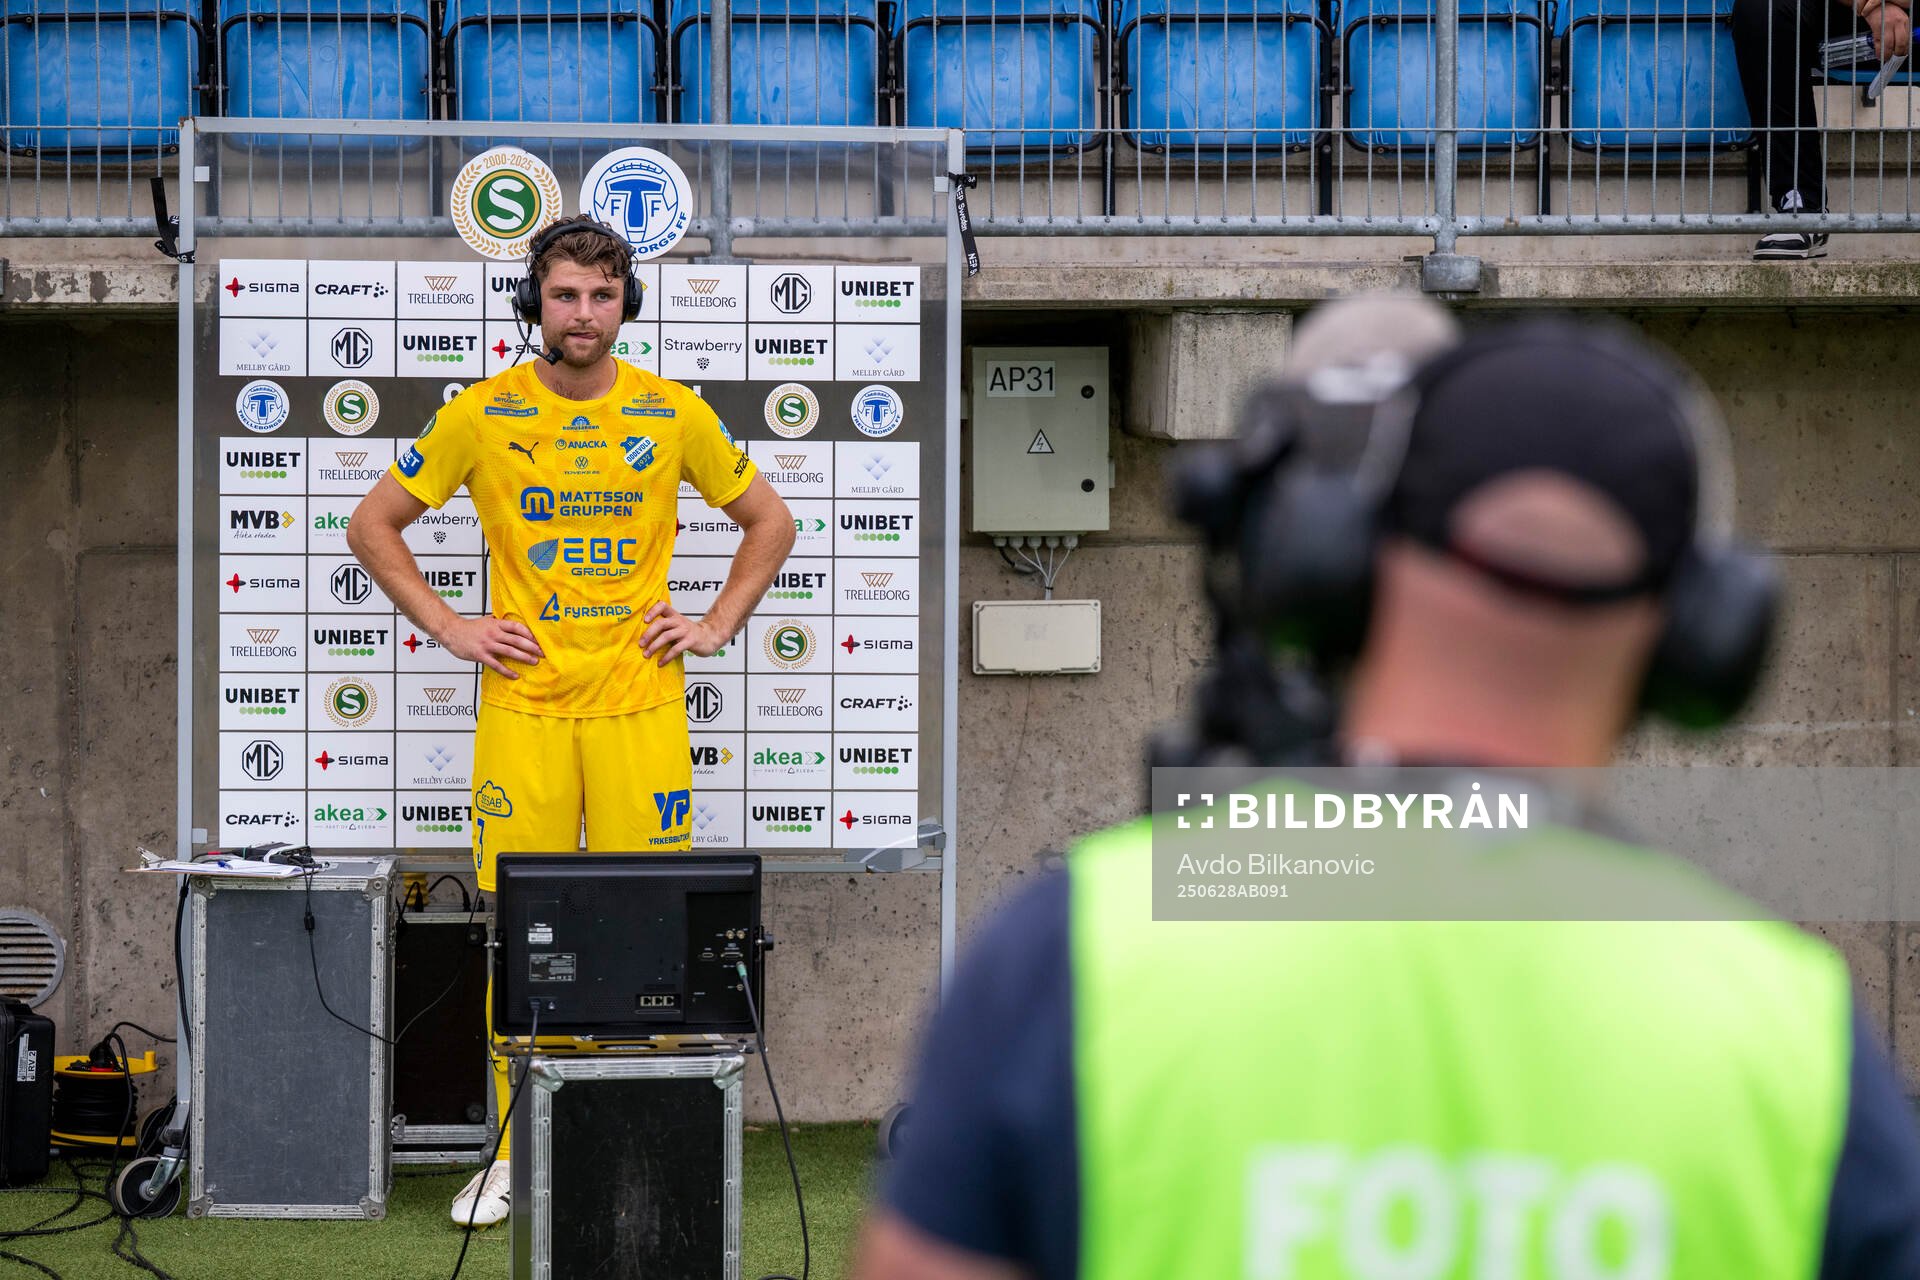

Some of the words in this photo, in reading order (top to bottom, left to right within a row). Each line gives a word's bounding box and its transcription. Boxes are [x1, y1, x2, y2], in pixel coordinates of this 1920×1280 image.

[483, 153, 534, 171] 2000-2025
[315, 284, 373, 296] CRAFT
[774, 277, 808, 311] MG
[841, 281, 914, 297] UNIBET
[408, 293, 474, 305] TRELLEBORG
[670, 296, 737, 308] TRELLEBORG
[335, 332, 369, 366] MG
[403, 335, 478, 351] UNIBET
[664, 338, 742, 354] Strawberry
[755, 339, 828, 355] UNIBET
[236, 364, 267, 372] MELLBY
[269, 362, 291, 372] GÅRD
[852, 369, 881, 377] MELLBY
[883, 368, 905, 377] GÅRD
[989, 366, 1055, 392] AP31
[568, 440, 608, 449] ANACKA
[626, 439, 652, 463] ODDEVOLD
[226, 452, 300, 468] UNIBET
[319, 469, 385, 481] TRELLEBORG
[560, 491, 644, 503] MATTSSON
[882, 485, 904, 494] GÅRD
[560, 505, 633, 517] GRUPPEN
[231, 510, 280, 530] MVB
[314, 512, 350, 530] ake
[411, 513, 479, 527] rawberry
[840, 515, 913, 531] UNIBET
[563, 537, 637, 565] EBC
[571, 567, 630, 577] GROUP
[334, 567, 369, 601] MG
[667, 580, 723, 592] CRAFT
[769, 573, 826, 589] NIBET
[844, 589, 910, 601] TRELLEBORG
[314, 630, 388, 645] UNIBET
[230, 646, 297, 657] TRELLEBORG
[225, 688, 300, 704] UNIBET
[686, 686, 719, 720] MG
[840, 698, 897, 709] CRAFT
[407, 704, 473, 716] TRELLEBORG
[757, 705, 823, 717] TRELLEBORG
[246, 743, 280, 777] MG
[690, 747, 718, 766] VB
[753, 748, 803, 765] akea
[840, 748, 912, 763] UNIBET
[413, 776, 442, 785] MELLBY
[444, 775, 467, 785] GÅRD
[225, 814, 283, 825] CRAFT
[314, 804, 364, 821] akea
[402, 806, 472, 821] UNIBET
[752, 806, 825, 821] UNIBET
[707, 834, 729, 843] GÅRD
[1243, 1140, 1676, 1280] FOTO
